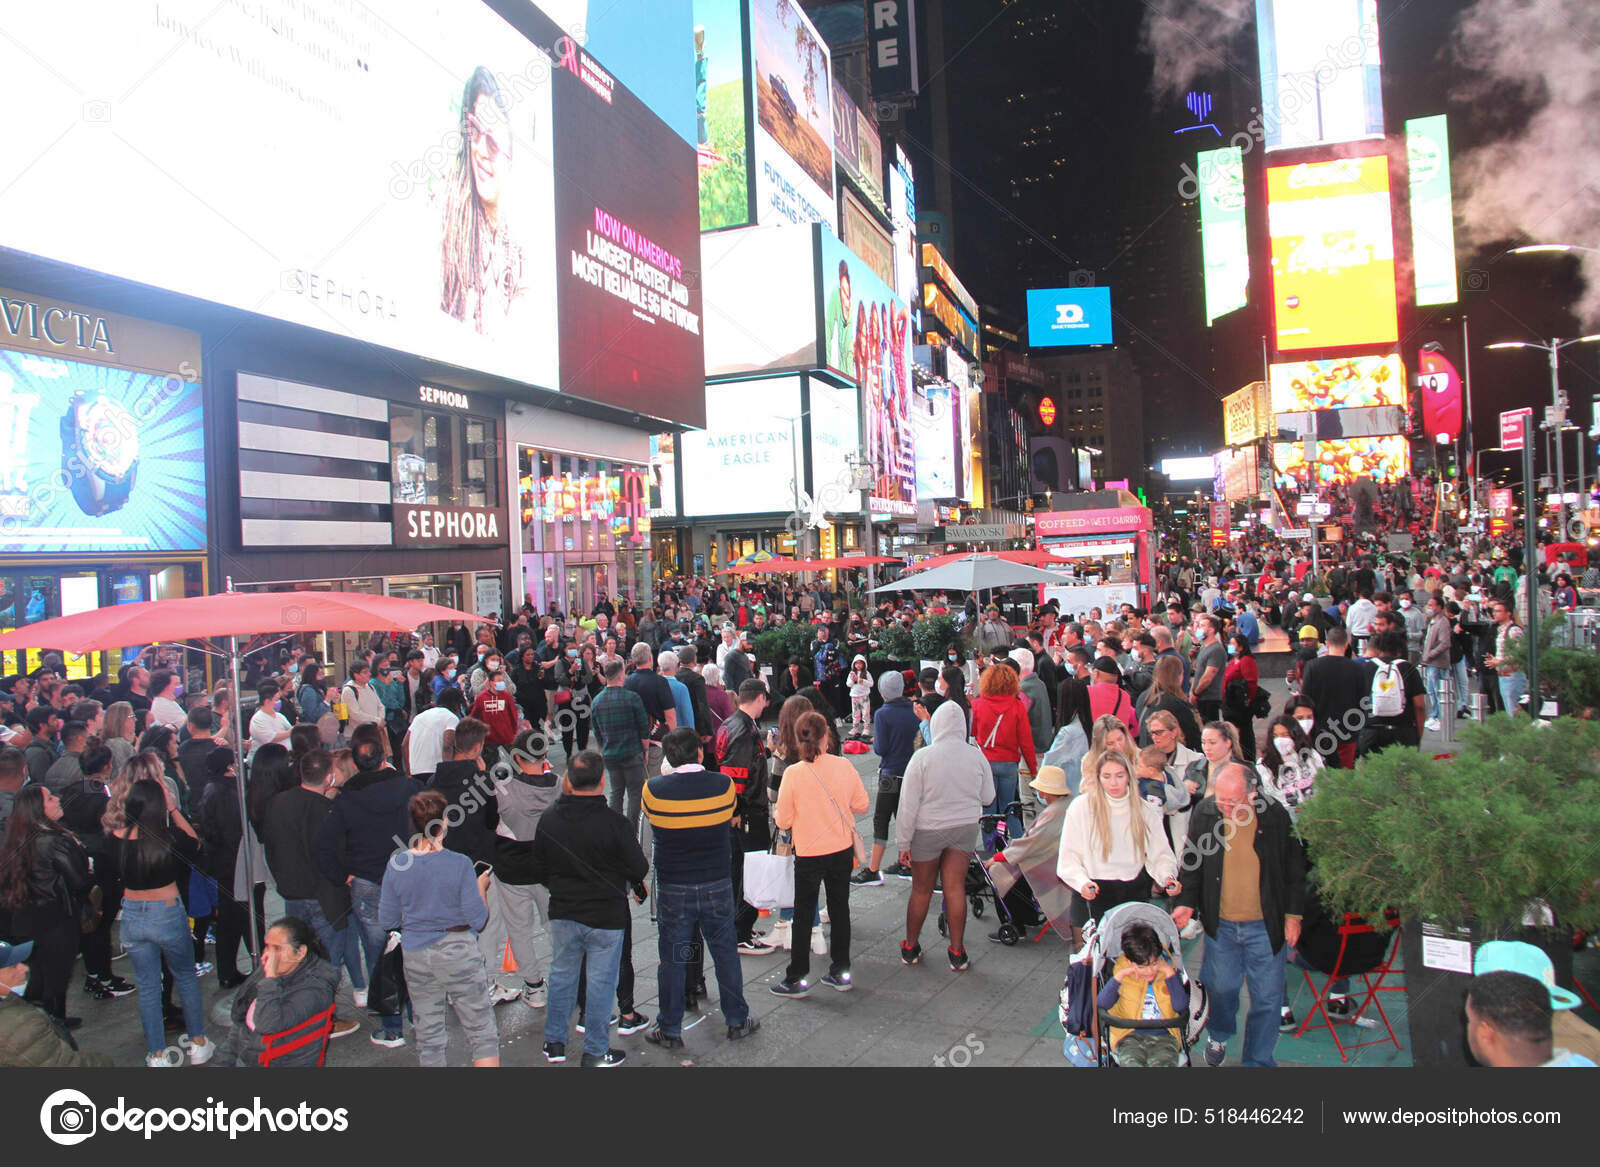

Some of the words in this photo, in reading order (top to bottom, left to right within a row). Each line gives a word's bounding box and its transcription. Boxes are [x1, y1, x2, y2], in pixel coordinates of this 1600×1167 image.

[764, 161, 796, 202] FUTURE
[770, 192, 797, 224] JEANS
[594, 206, 621, 243] NOW
[621, 224, 636, 253] ON
[637, 235, 682, 280] AMERICA'S
[586, 229, 634, 281] LARGEST,
[633, 256, 671, 301] FASTEST,
[671, 279, 689, 307] AND
[571, 249, 603, 288] MOST
[604, 267, 648, 310] RELIABLE
[660, 297, 700, 336] NETWORK
[419, 385, 469, 409] SEPHORA
[706, 431, 789, 449] AMERICAN
[723, 451, 771, 466] EAGLE
[1214, 504, 1226, 528] tkts
[1494, 490, 1509, 517] tkts
[407, 510, 499, 538] SEPHORA
[946, 527, 1005, 538] SWAROVSKI
[1039, 519, 1086, 529] COFFEED
